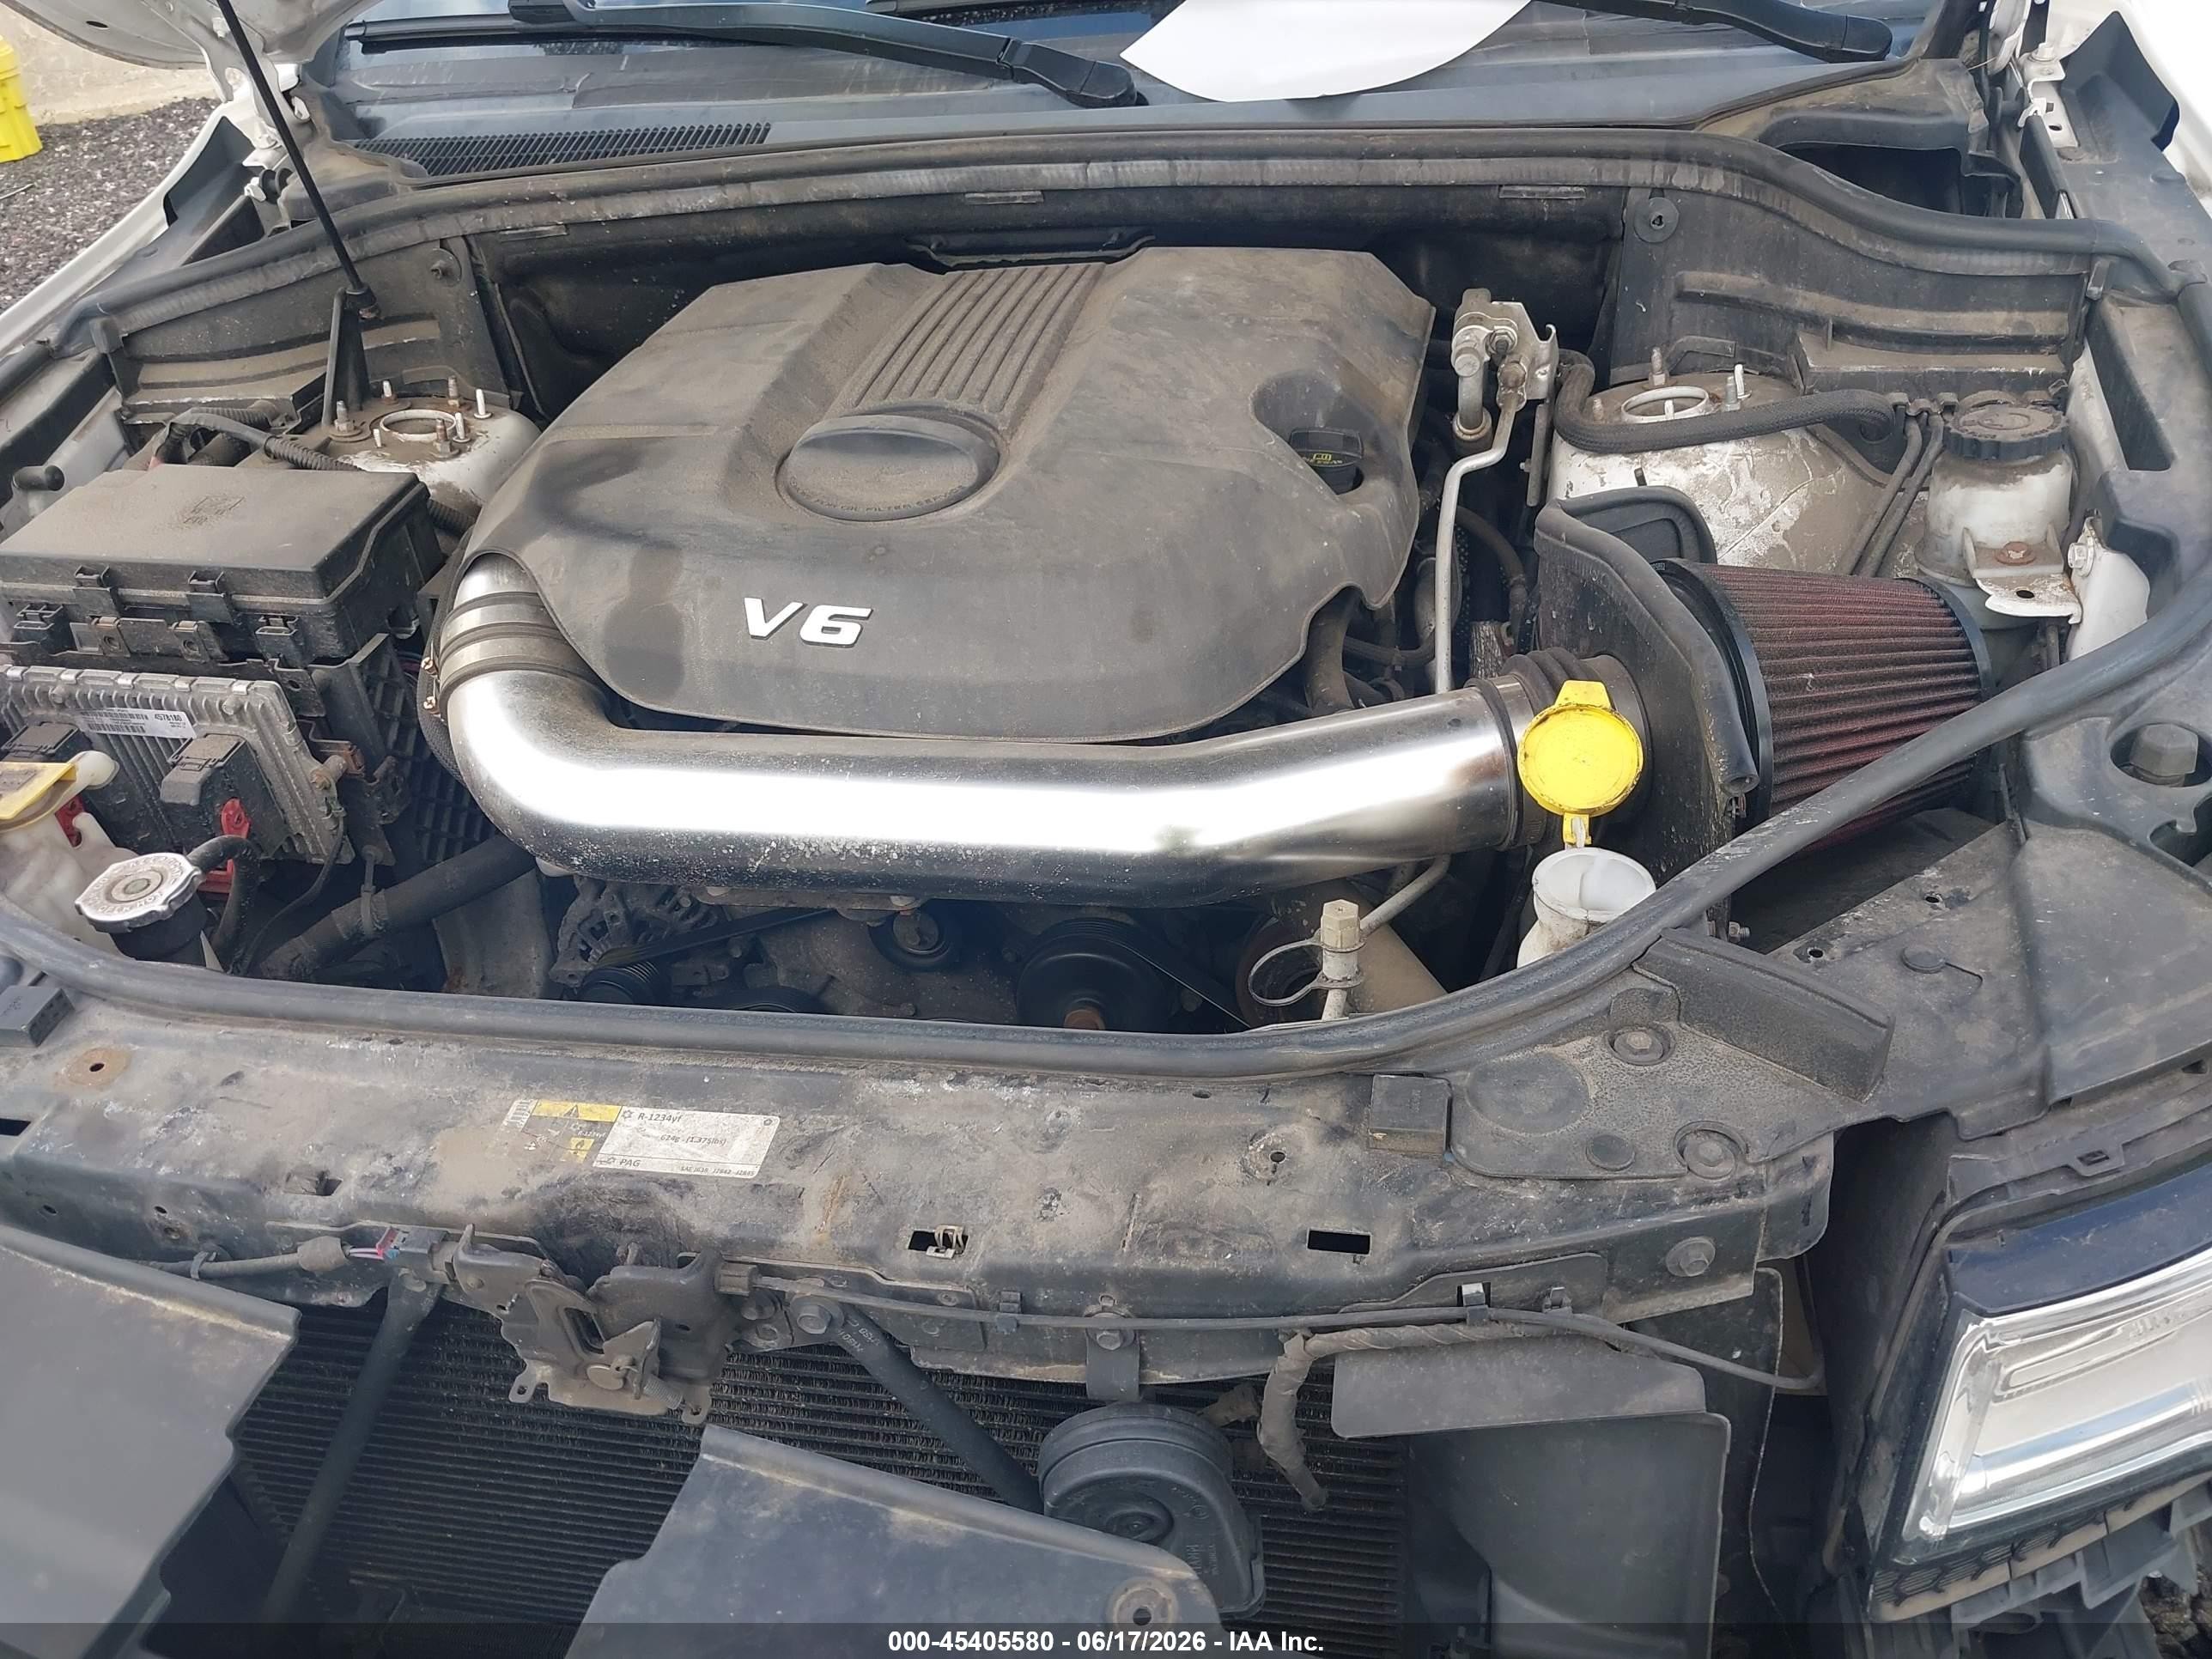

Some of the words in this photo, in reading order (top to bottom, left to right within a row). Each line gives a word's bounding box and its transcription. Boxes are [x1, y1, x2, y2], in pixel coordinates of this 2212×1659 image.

[744, 597, 873, 648] V6
[637, 1112, 682, 1124] R-1234yf
[619, 1159, 641, 1168] PAG
